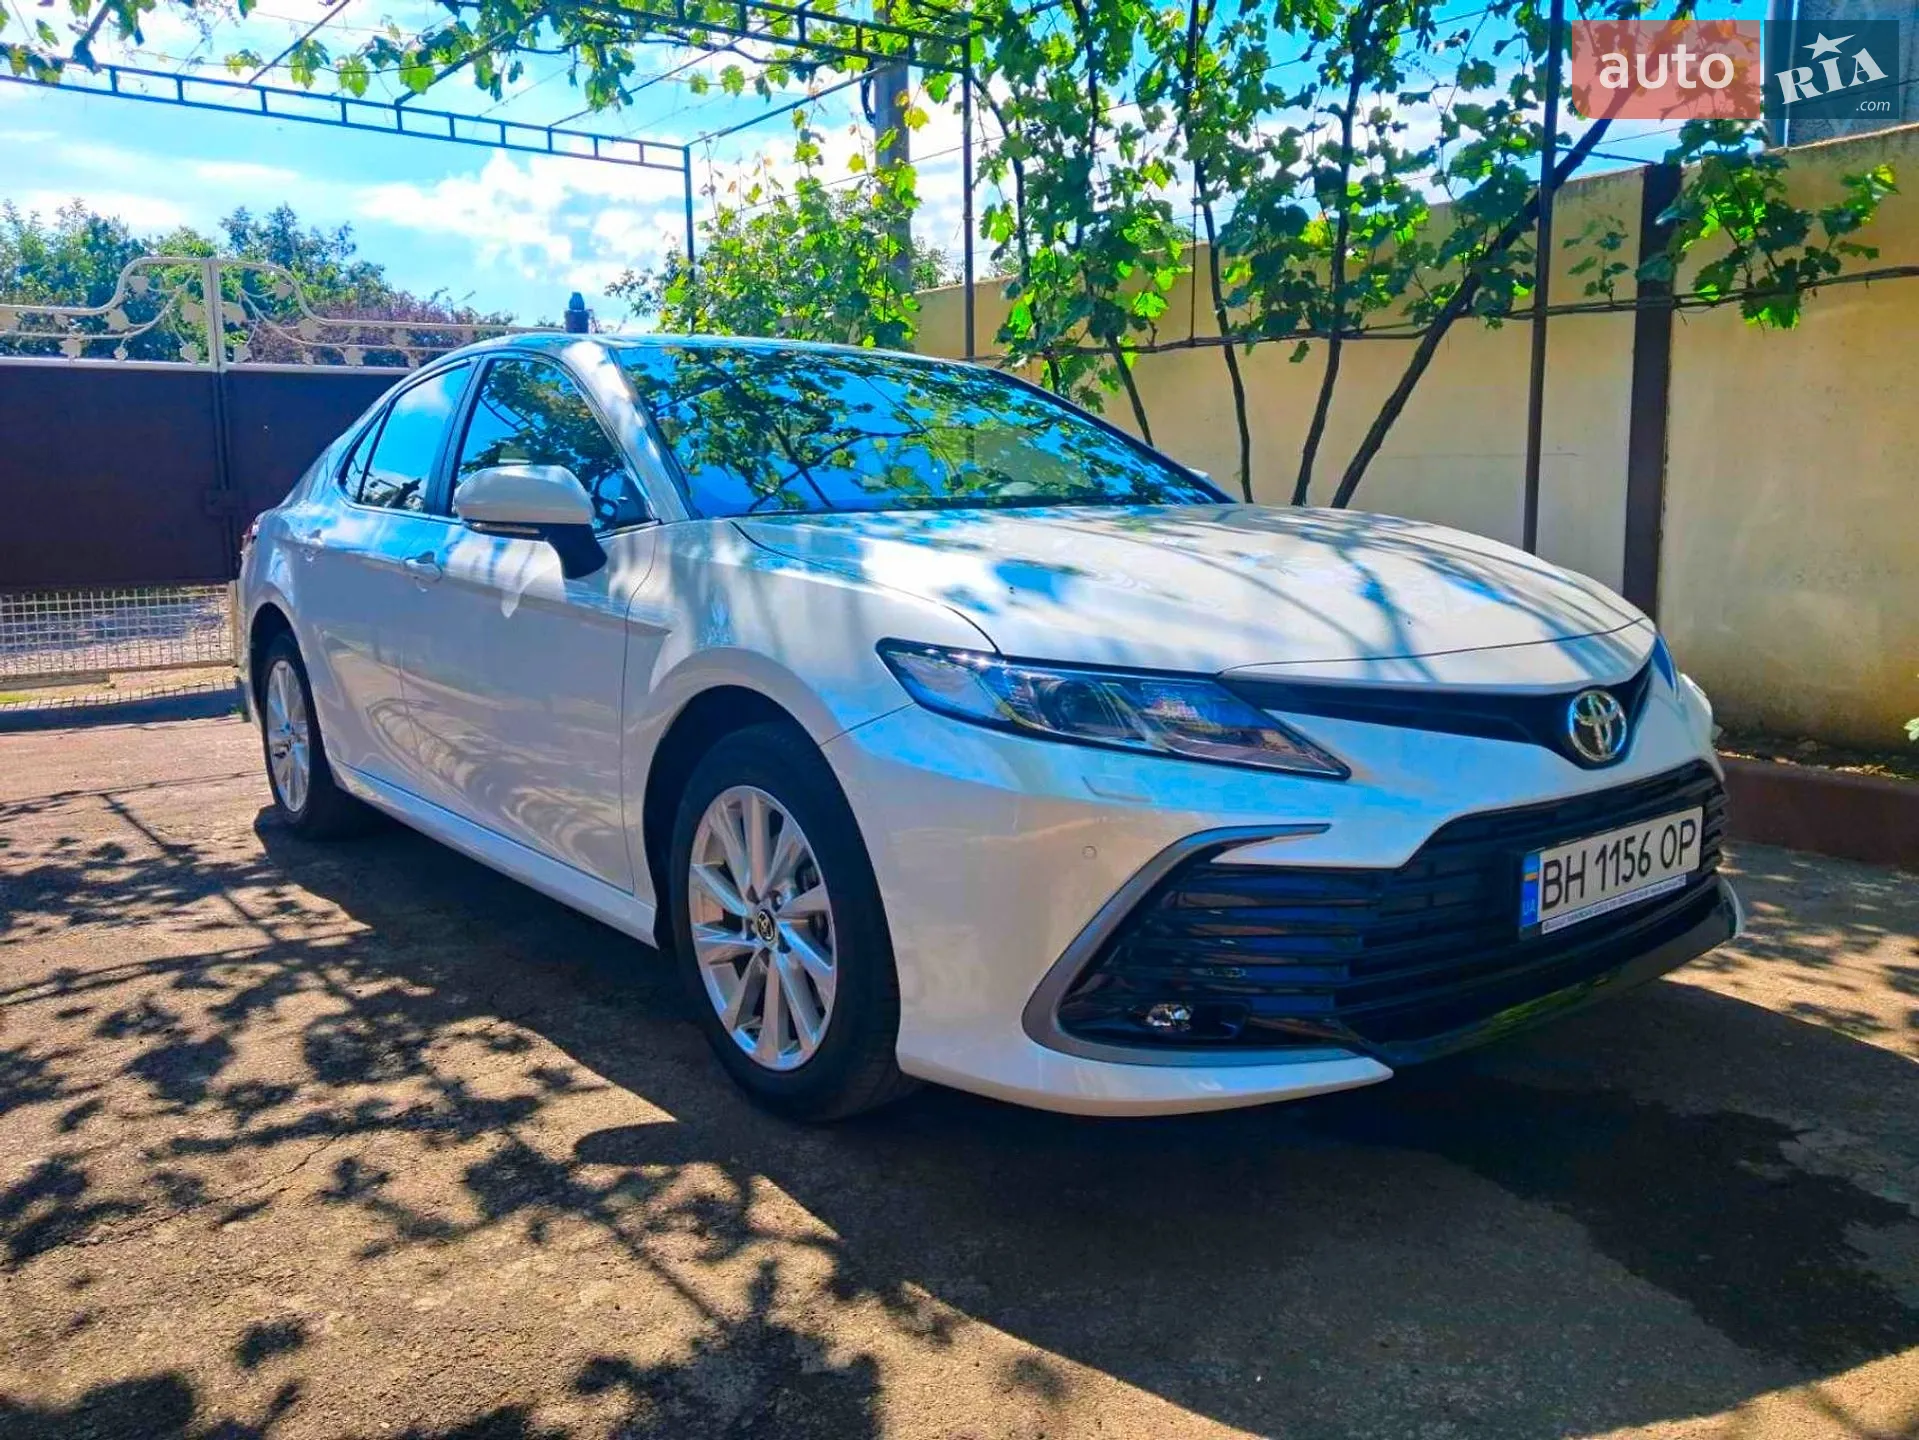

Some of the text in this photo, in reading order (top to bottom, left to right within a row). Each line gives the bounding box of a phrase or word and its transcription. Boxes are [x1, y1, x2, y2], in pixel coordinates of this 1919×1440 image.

[1542, 850, 1587, 910] BH
[1595, 830, 1651, 891] 1156
[1660, 818, 1696, 869] OP
[1522, 898, 1536, 917] UA
